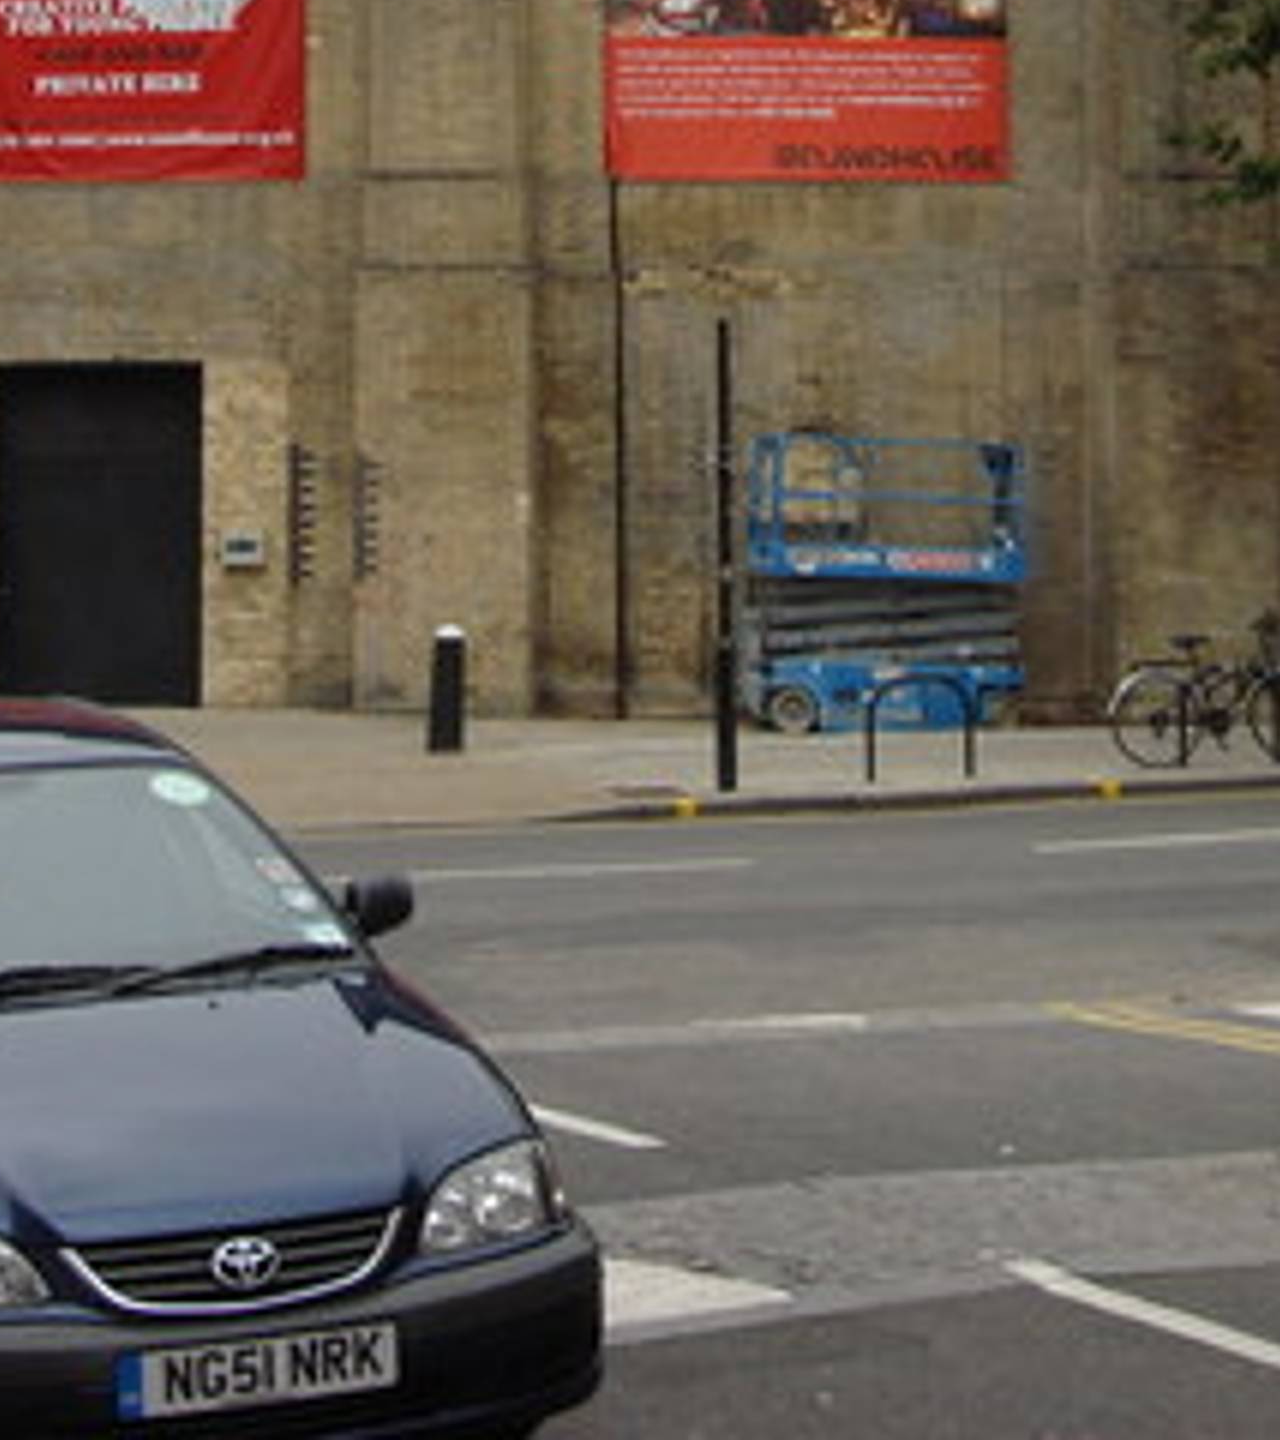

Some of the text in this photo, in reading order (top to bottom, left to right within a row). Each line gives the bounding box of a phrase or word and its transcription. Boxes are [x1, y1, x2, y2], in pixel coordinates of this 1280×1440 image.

[34, 71, 201, 96] PRIVATE HIRE
[164, 1331, 383, 1405] NG51 NRK
